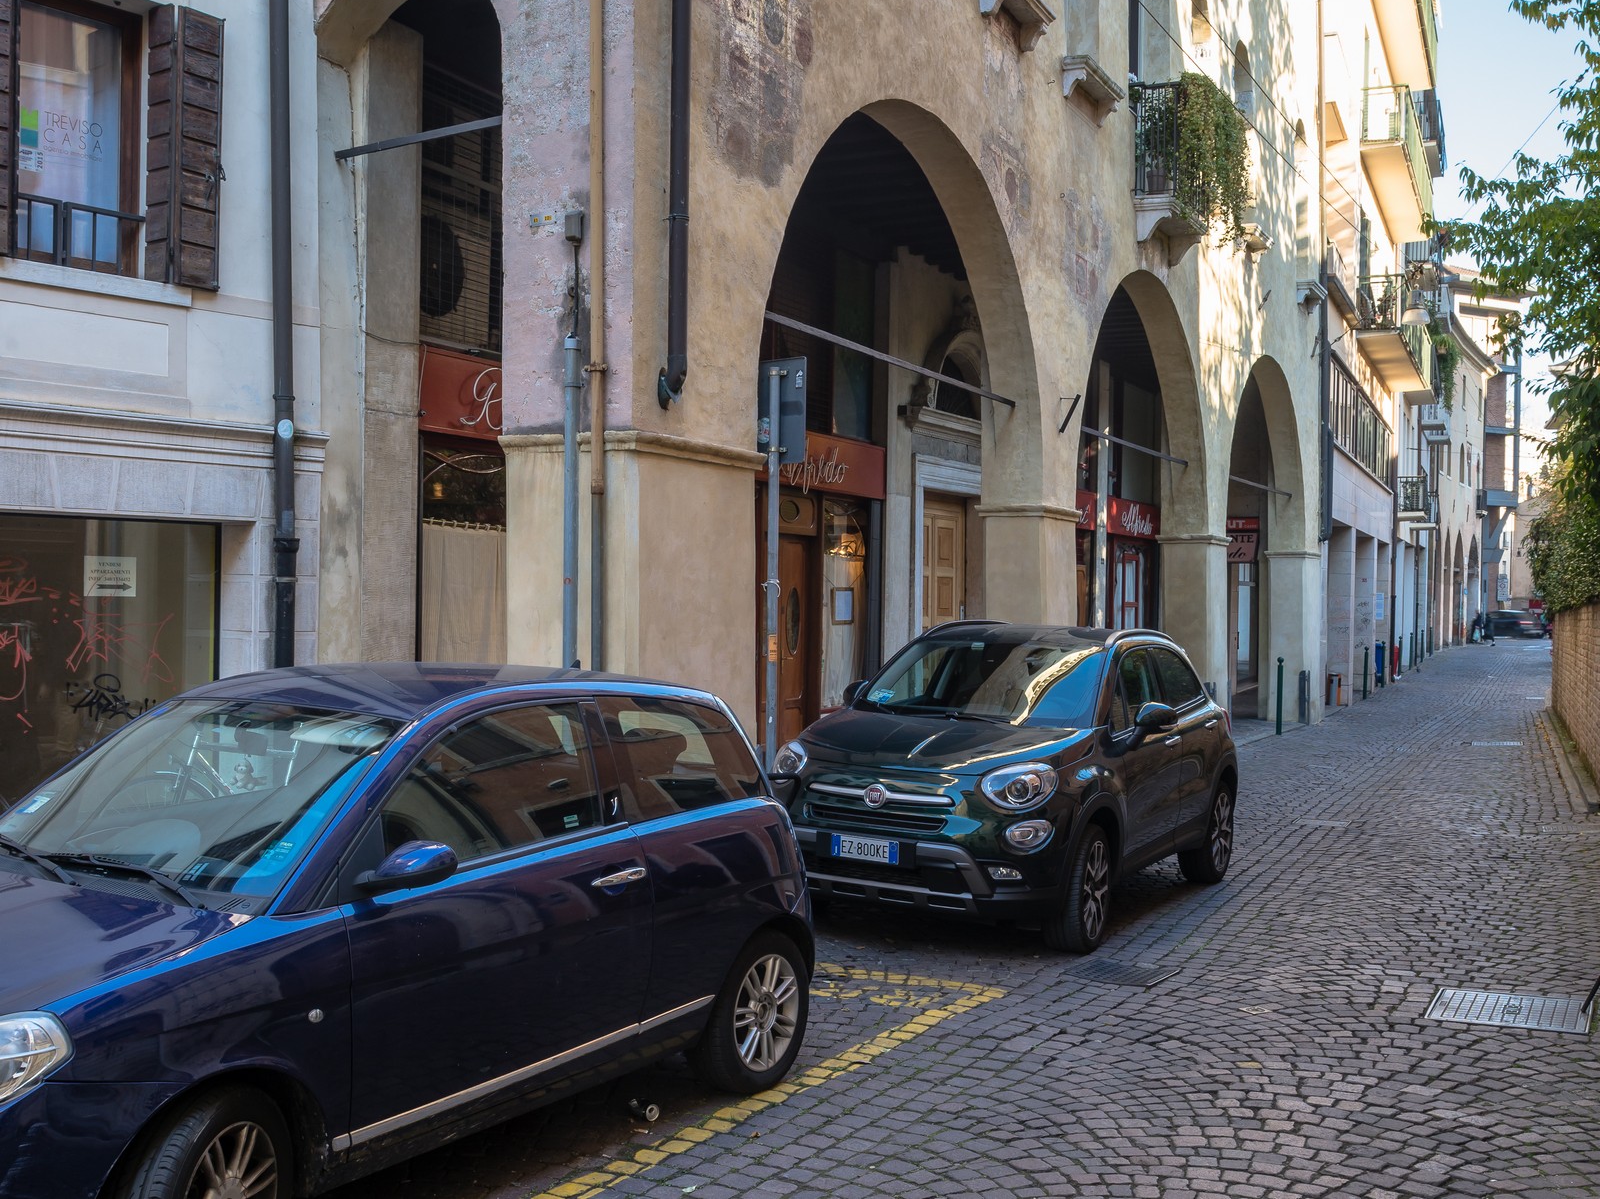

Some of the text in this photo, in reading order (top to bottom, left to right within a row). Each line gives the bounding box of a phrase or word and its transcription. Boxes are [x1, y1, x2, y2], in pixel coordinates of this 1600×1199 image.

[44, 110, 103, 138] TREVISO
[43, 128, 102, 154] CASA
[869, 791, 881, 802] FIAT
[841, 839, 854, 854] EZ
[856, 842, 889, 859] 800KE
